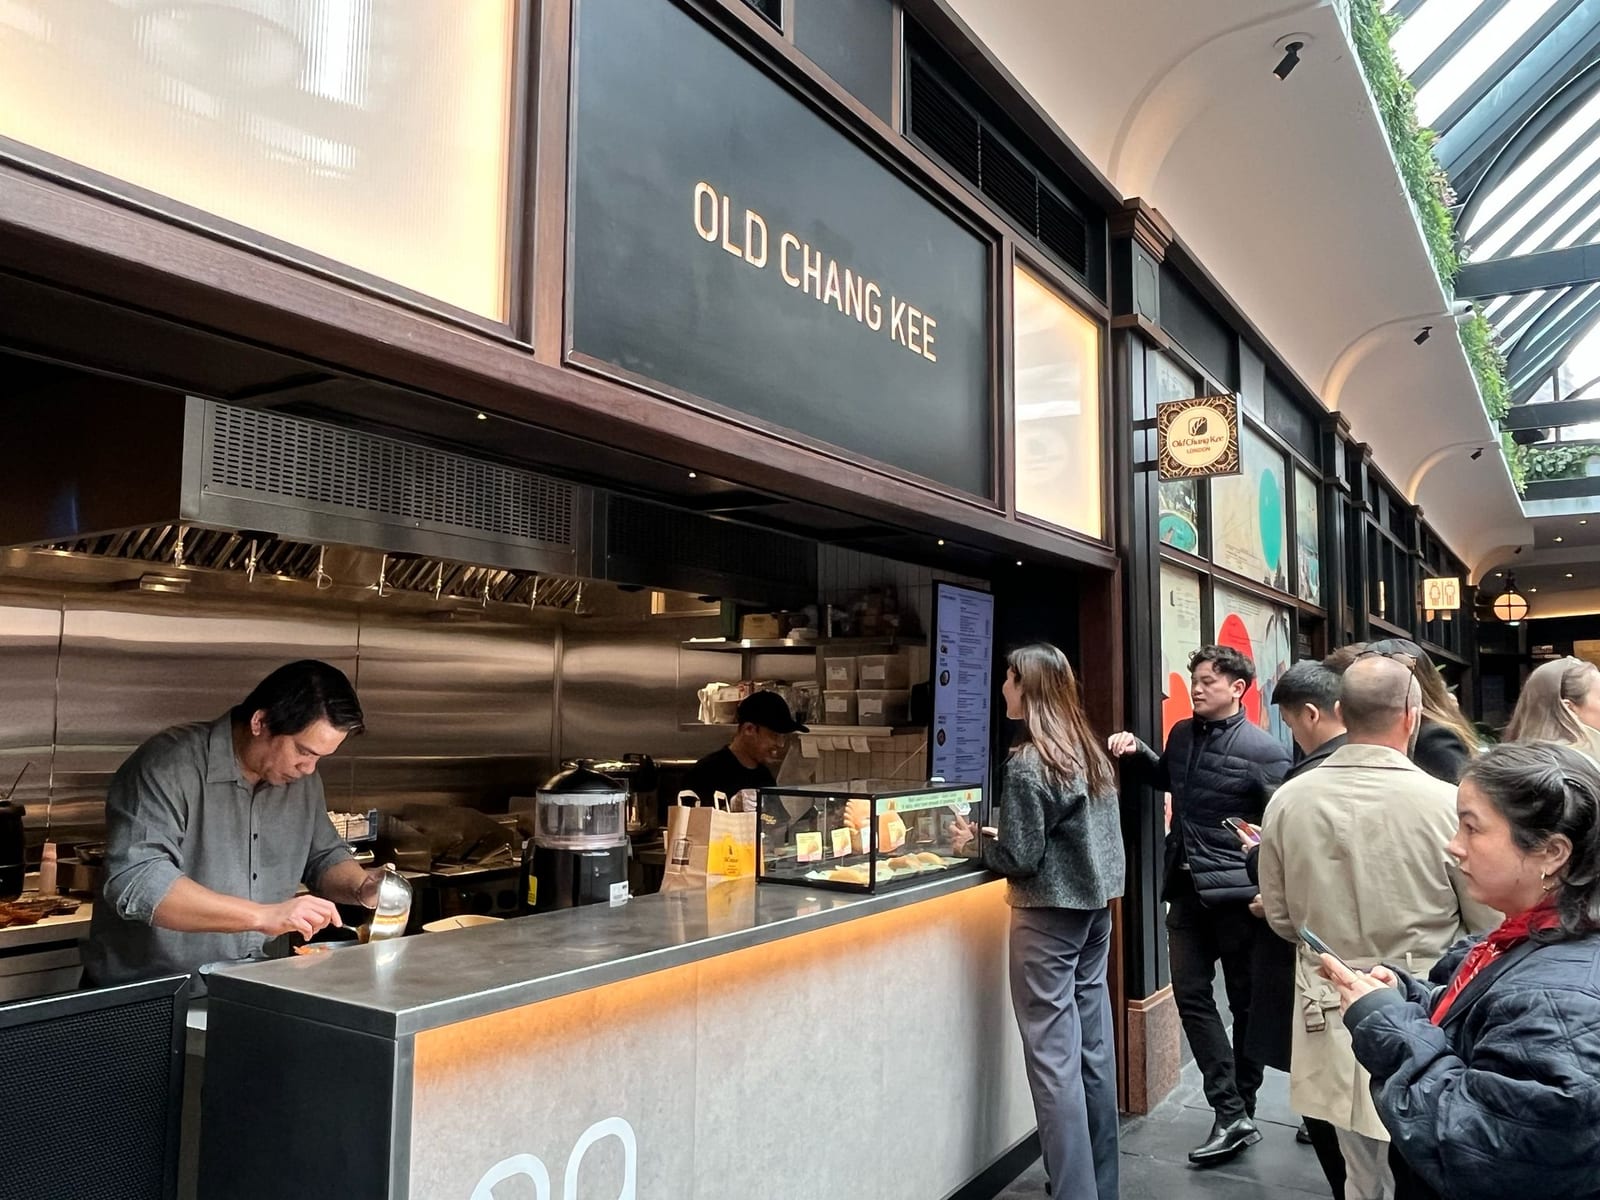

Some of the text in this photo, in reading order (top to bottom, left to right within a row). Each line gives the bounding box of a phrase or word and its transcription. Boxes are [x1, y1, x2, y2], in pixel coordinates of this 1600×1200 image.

[693, 181, 937, 363] OLD CHANG KEE
